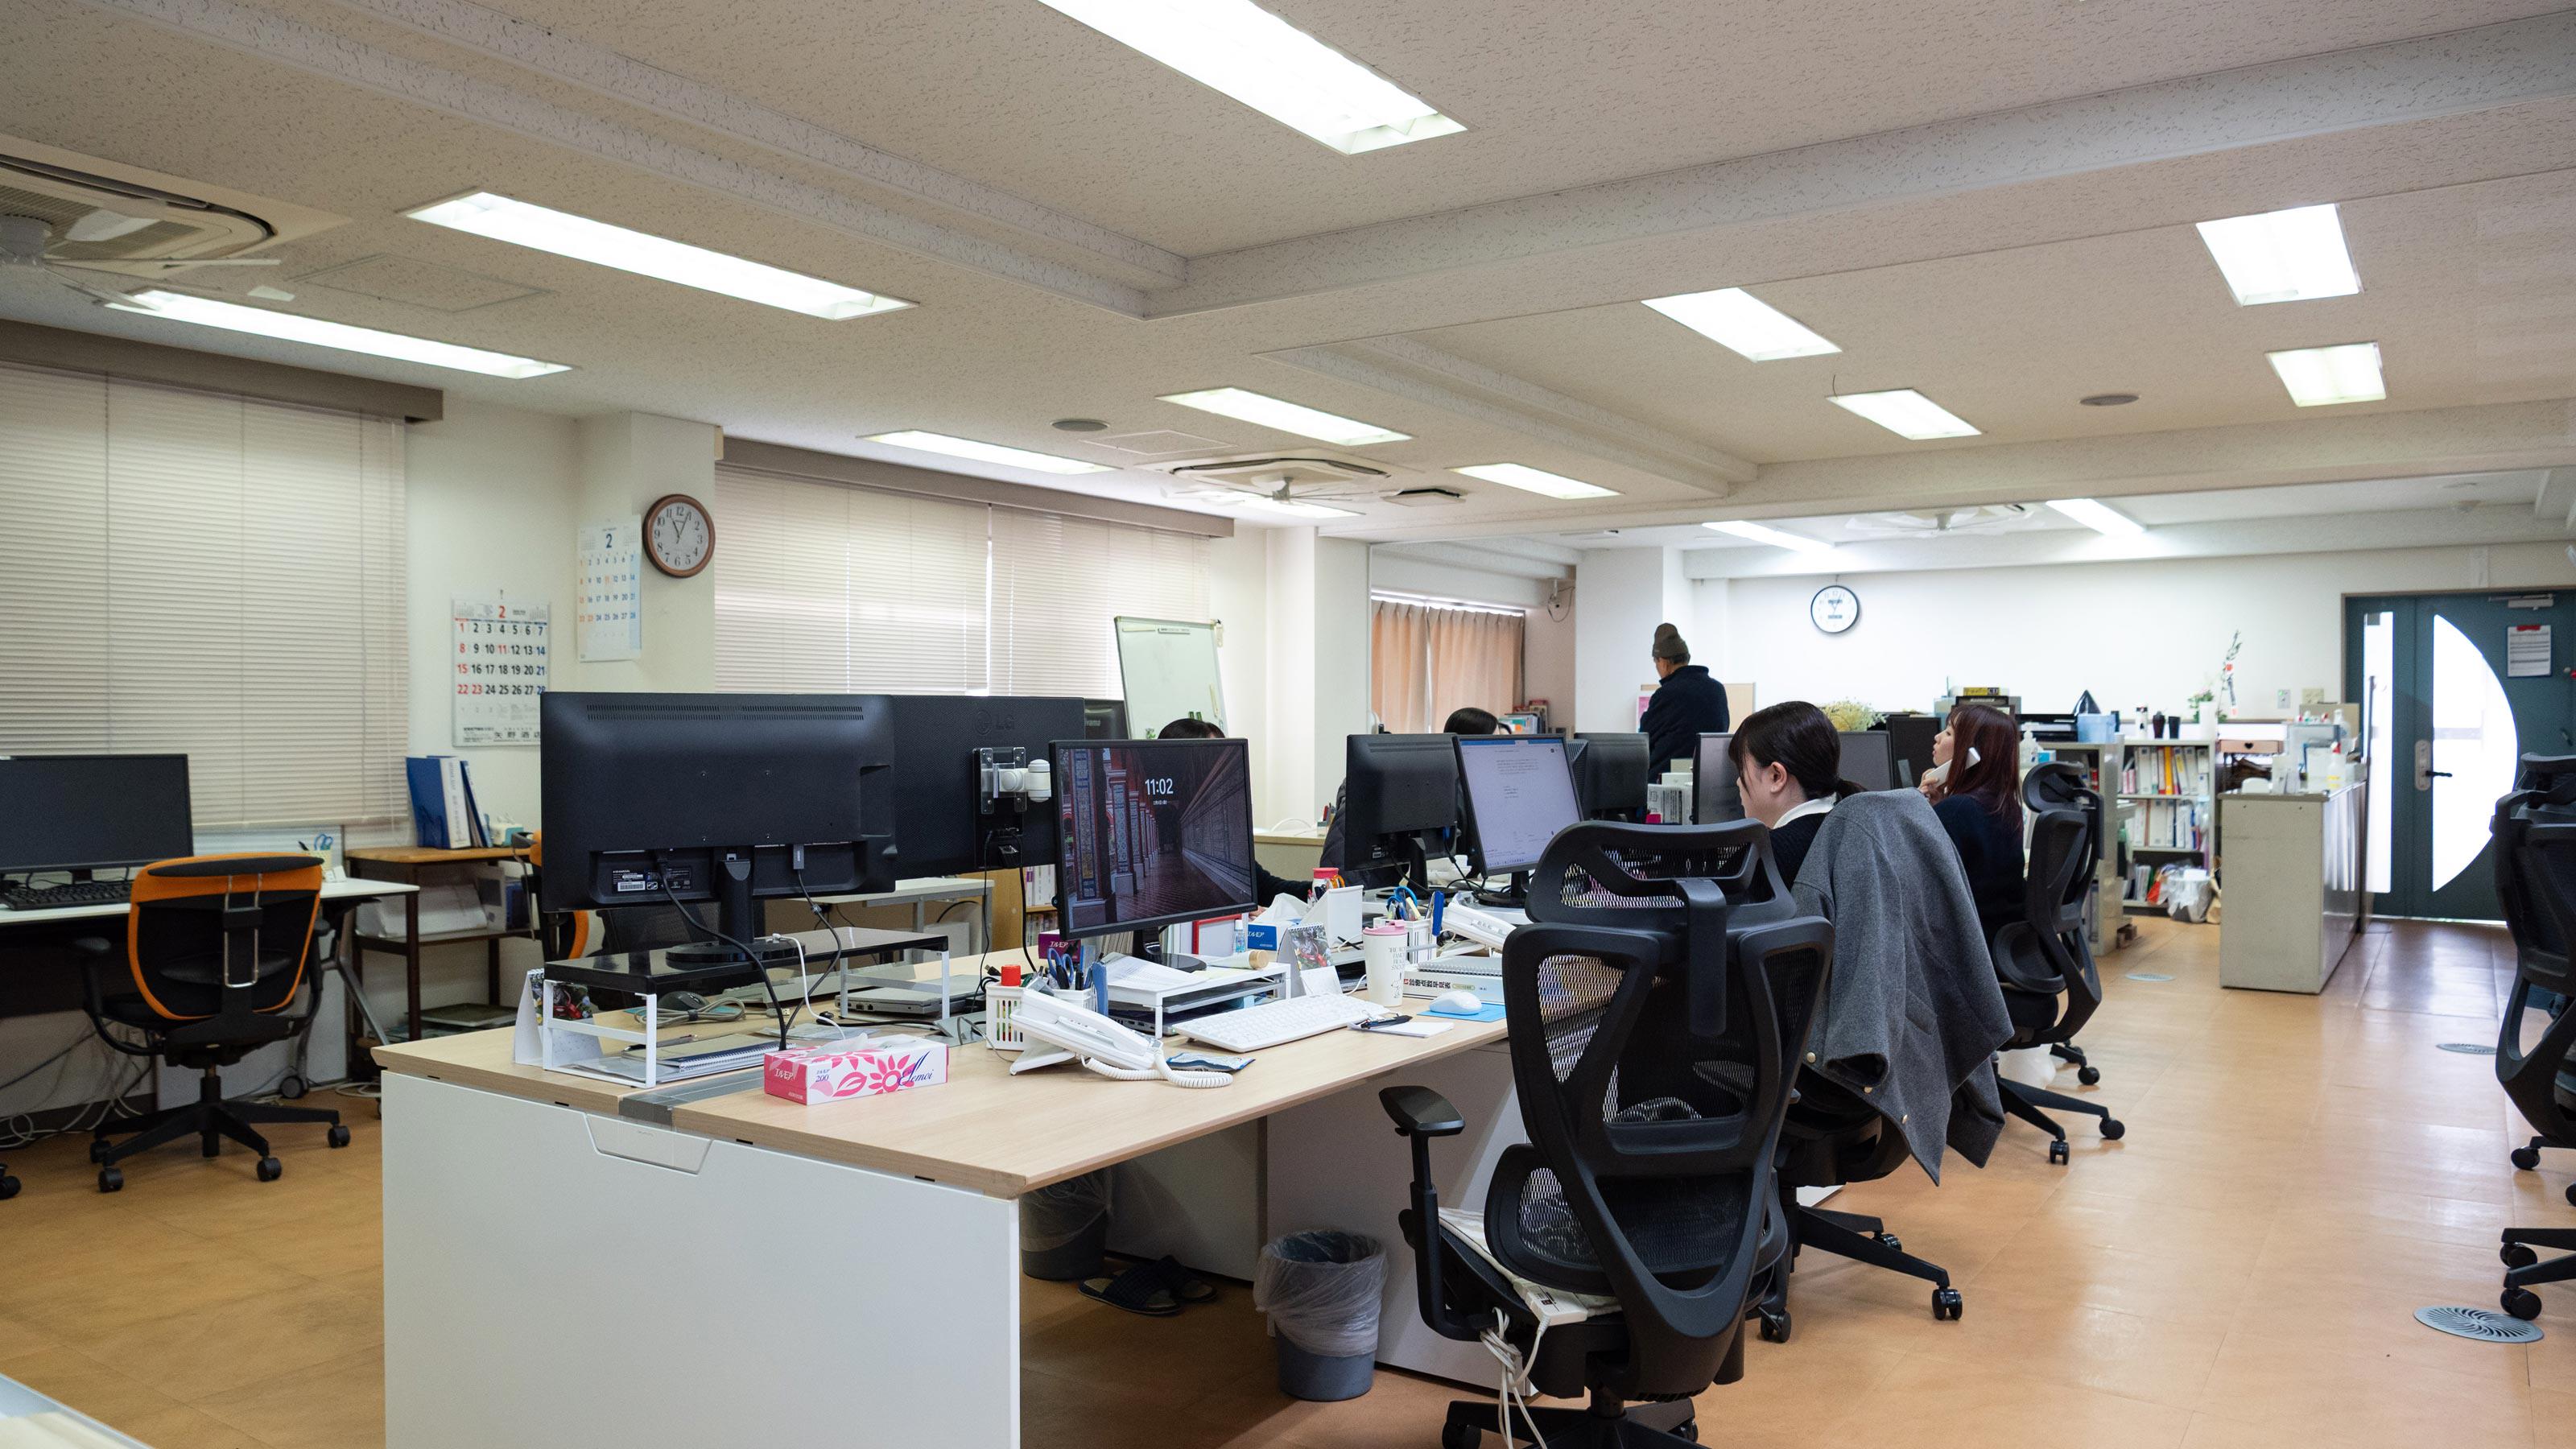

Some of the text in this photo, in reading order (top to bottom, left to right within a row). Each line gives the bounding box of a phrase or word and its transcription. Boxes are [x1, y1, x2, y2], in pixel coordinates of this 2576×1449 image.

[667, 509, 672, 518] 11
[677, 506, 684, 516] 12
[658, 517, 665, 526] 10
[695, 522, 700, 530] 2
[606, 534, 612, 548] 2
[697, 535, 702, 544] 3
[675, 556, 680, 566] 6
[685, 555, 691, 564] 5
[498, 605, 506, 618] 2
[460, 623, 543, 636] 1 2 3 4 5 6 7
[460, 643, 545, 655] 8 9 10 11 12 13 14
[457, 664, 545, 675] 15 16 17 18 19 20 21
[457, 684, 545, 695] 22 23 24 25 26 27 28
[1145, 778, 1174, 795] 11:02
